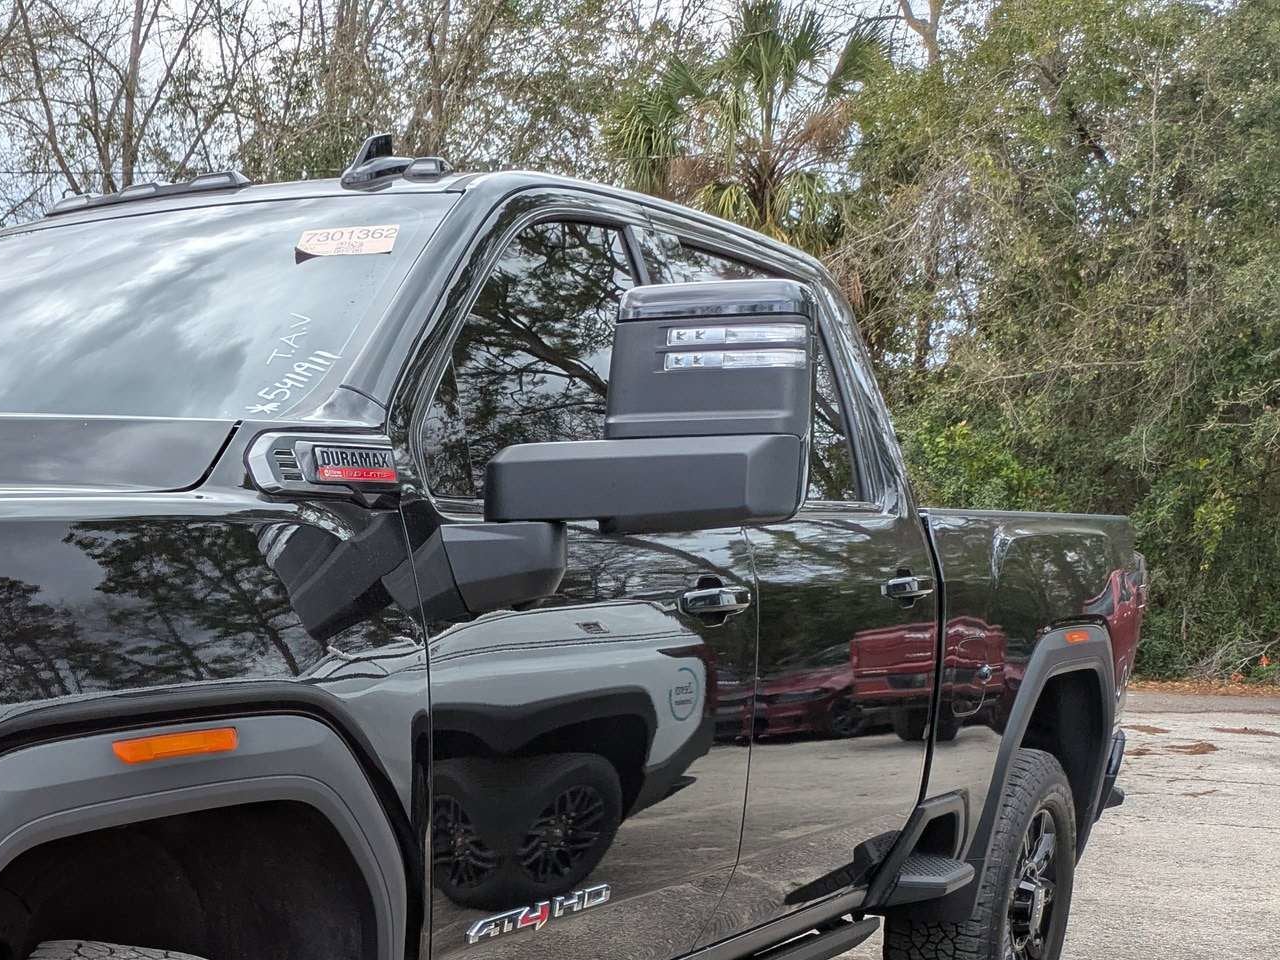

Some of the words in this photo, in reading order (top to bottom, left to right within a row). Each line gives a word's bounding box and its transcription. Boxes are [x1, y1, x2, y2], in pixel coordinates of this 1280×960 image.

[304, 227, 398, 243] 7301362
[320, 449, 390, 468] DURAMAX
[465, 900, 550, 944] AT4
[552, 883, 611, 918] HD
